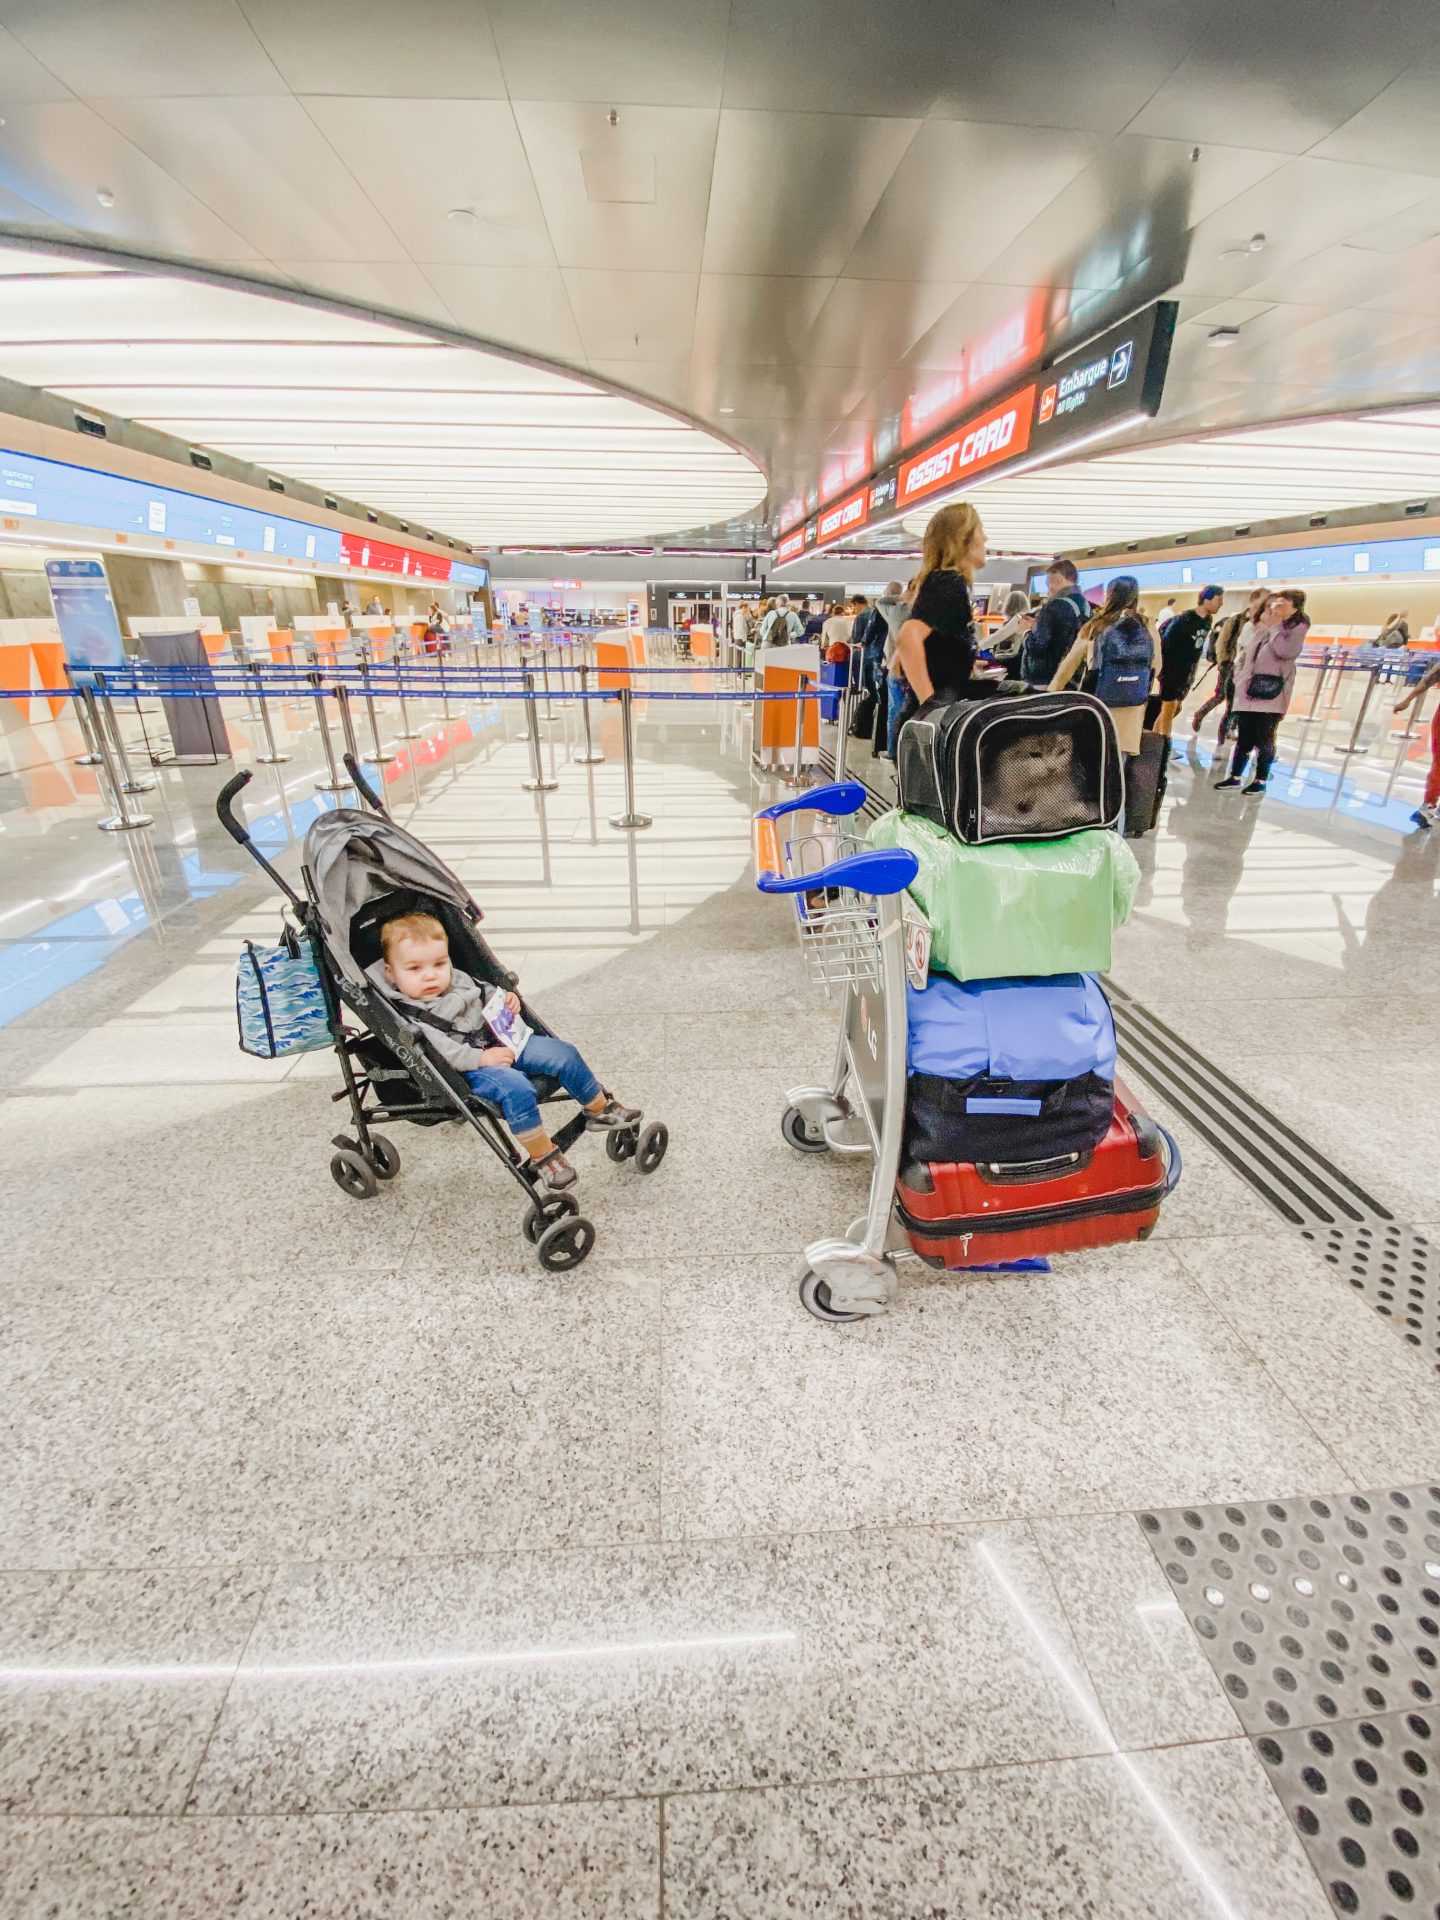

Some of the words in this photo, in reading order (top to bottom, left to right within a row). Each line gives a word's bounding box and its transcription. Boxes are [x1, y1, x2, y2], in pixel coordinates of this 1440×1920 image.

[1058, 359, 1108, 398] Embarque
[905, 441, 960, 495] ASSIST
[959, 410, 1016, 467] CARD
[334, 974, 369, 1006] Jeep
[867, 1017, 878, 1062] LG
